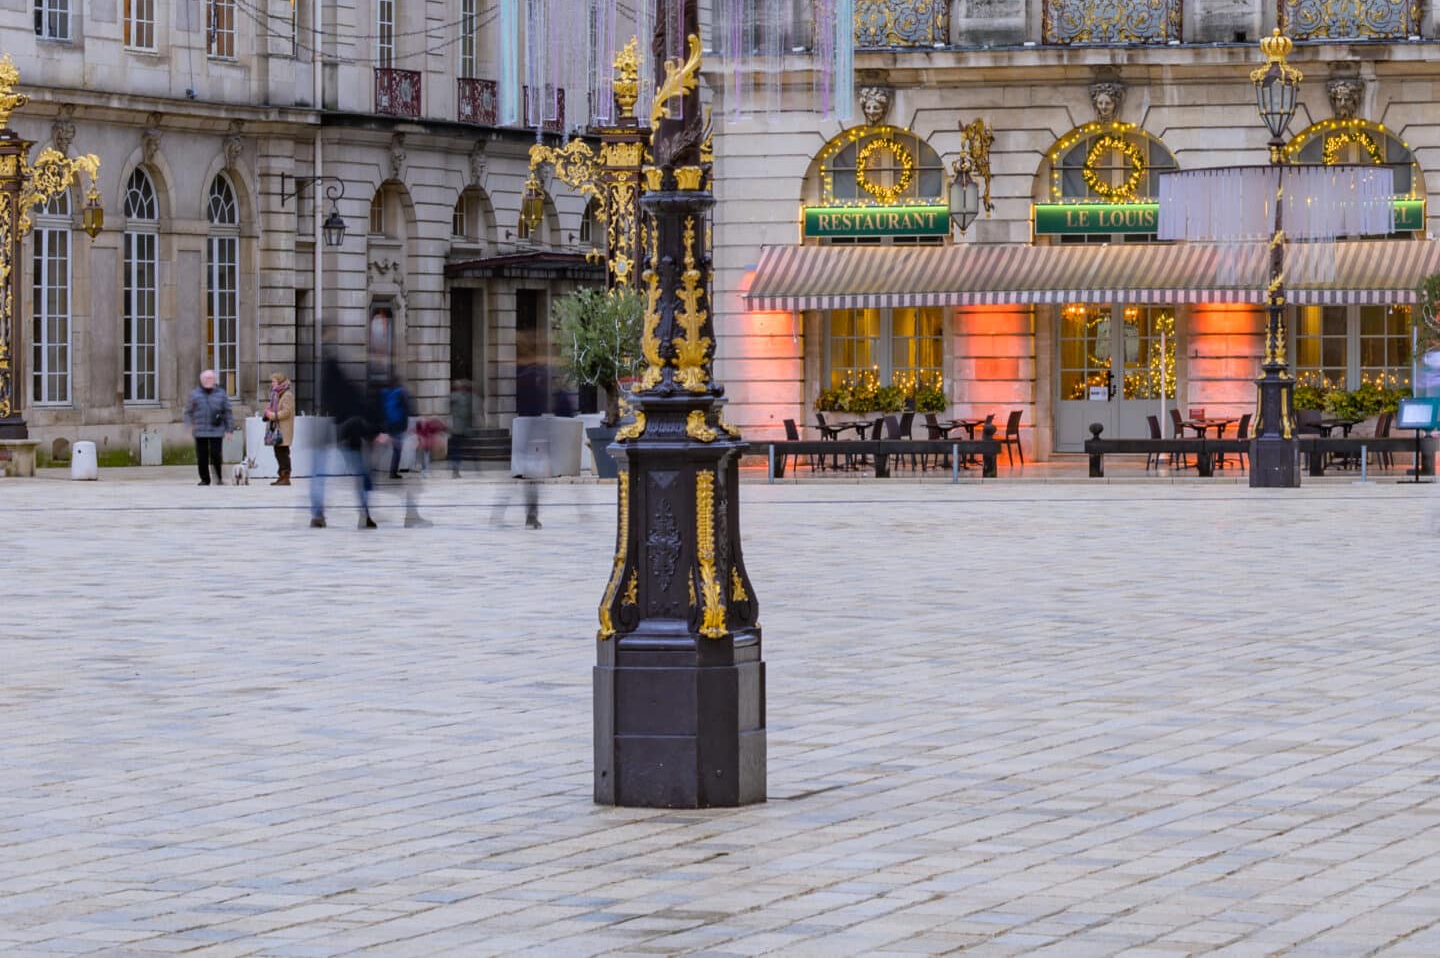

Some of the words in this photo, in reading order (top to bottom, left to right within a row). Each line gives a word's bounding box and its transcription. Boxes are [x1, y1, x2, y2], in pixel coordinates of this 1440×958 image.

[818, 211, 937, 231] RESTAURANT
[1066, 210, 1089, 227] LE
[1098, 209, 1154, 227] LOUIS
